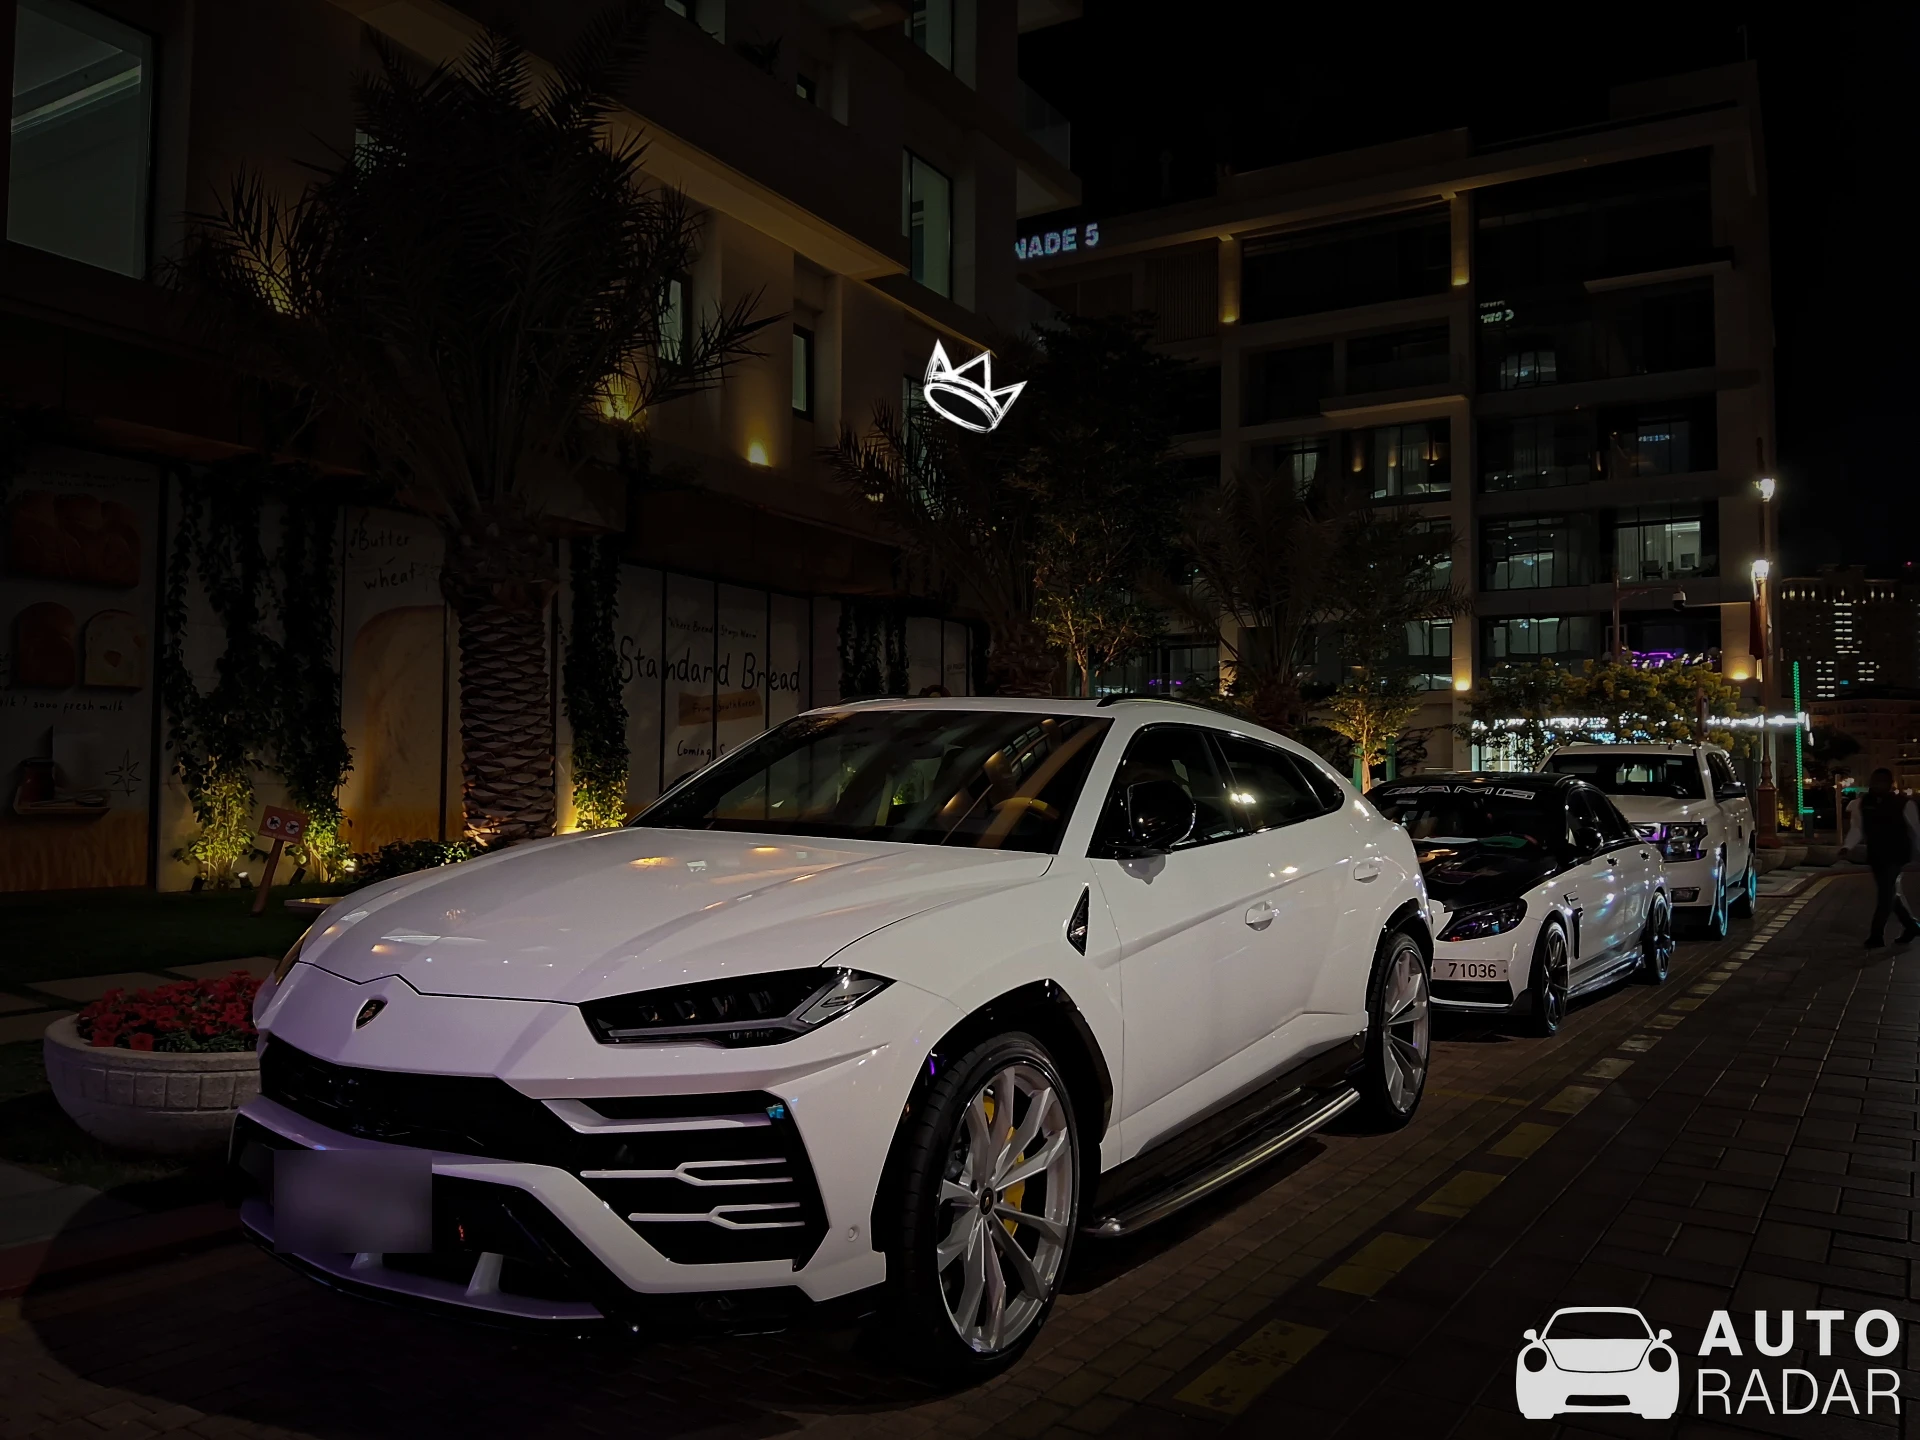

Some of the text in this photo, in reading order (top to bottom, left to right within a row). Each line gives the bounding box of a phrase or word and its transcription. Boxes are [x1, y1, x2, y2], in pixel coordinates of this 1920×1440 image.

[1014, 222, 1099, 260] NADE 5
[358, 529, 410, 550] Butter
[363, 562, 416, 589] wheat
[619, 635, 801, 693] Standard Bread
[62, 699, 95, 713] fresh
[99, 700, 124, 712] milk
[677, 739, 712, 766] Coming
[1419, 785, 1536, 801] AMG
[1448, 962, 1497, 979] 71036
